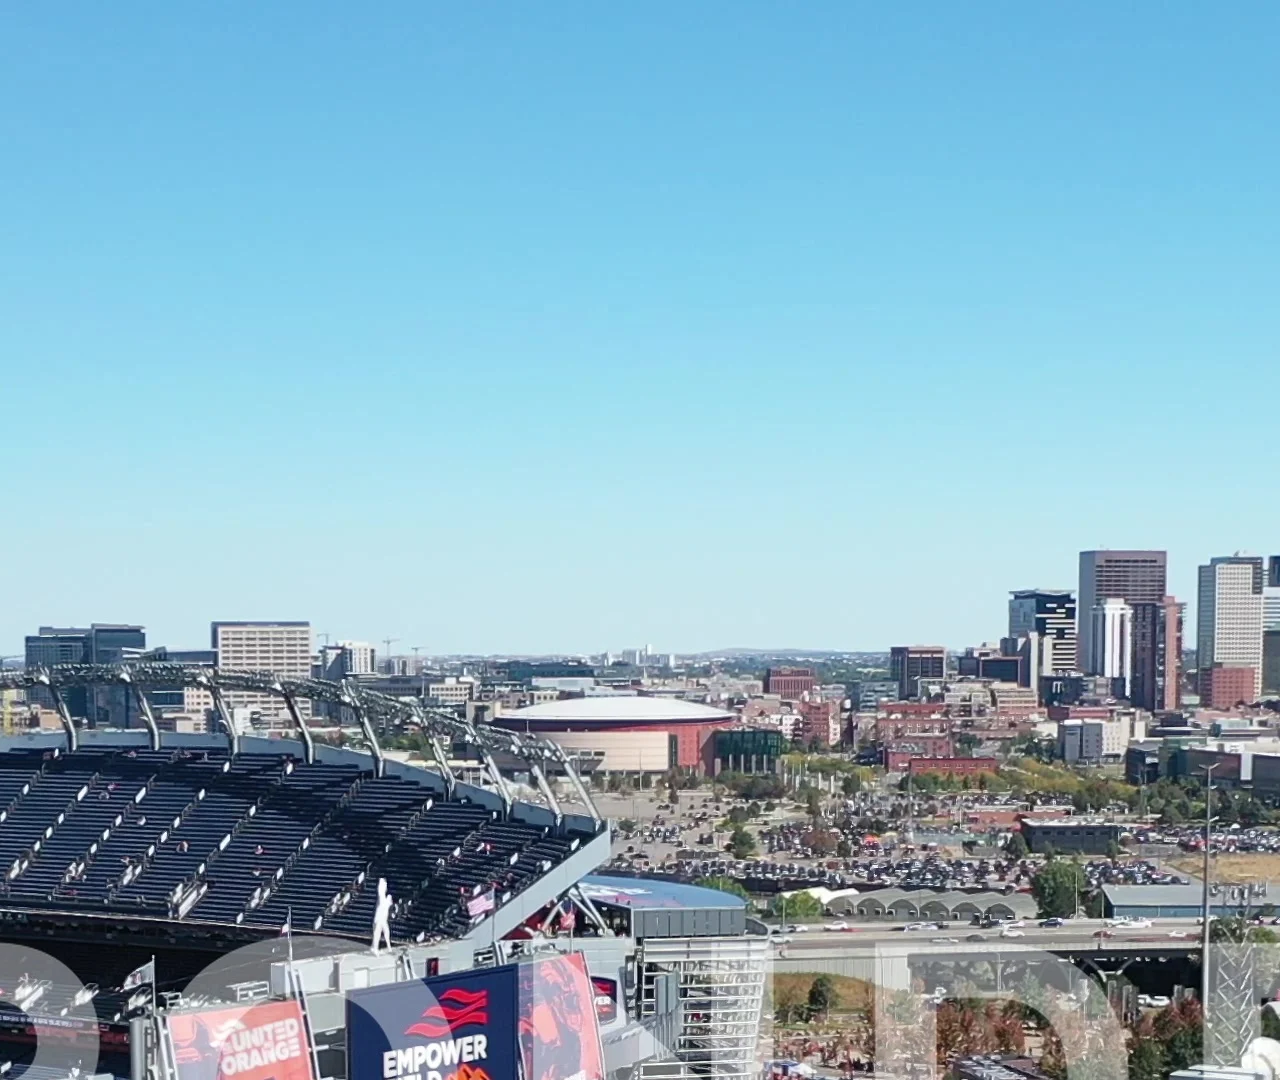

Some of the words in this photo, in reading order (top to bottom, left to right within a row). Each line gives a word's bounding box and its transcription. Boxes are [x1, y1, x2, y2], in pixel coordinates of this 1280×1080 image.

[231, 1018, 299, 1052] UNITED
[221, 1037, 301, 1076] ORANGE
[382, 1033, 488, 1078] EMPOWER
